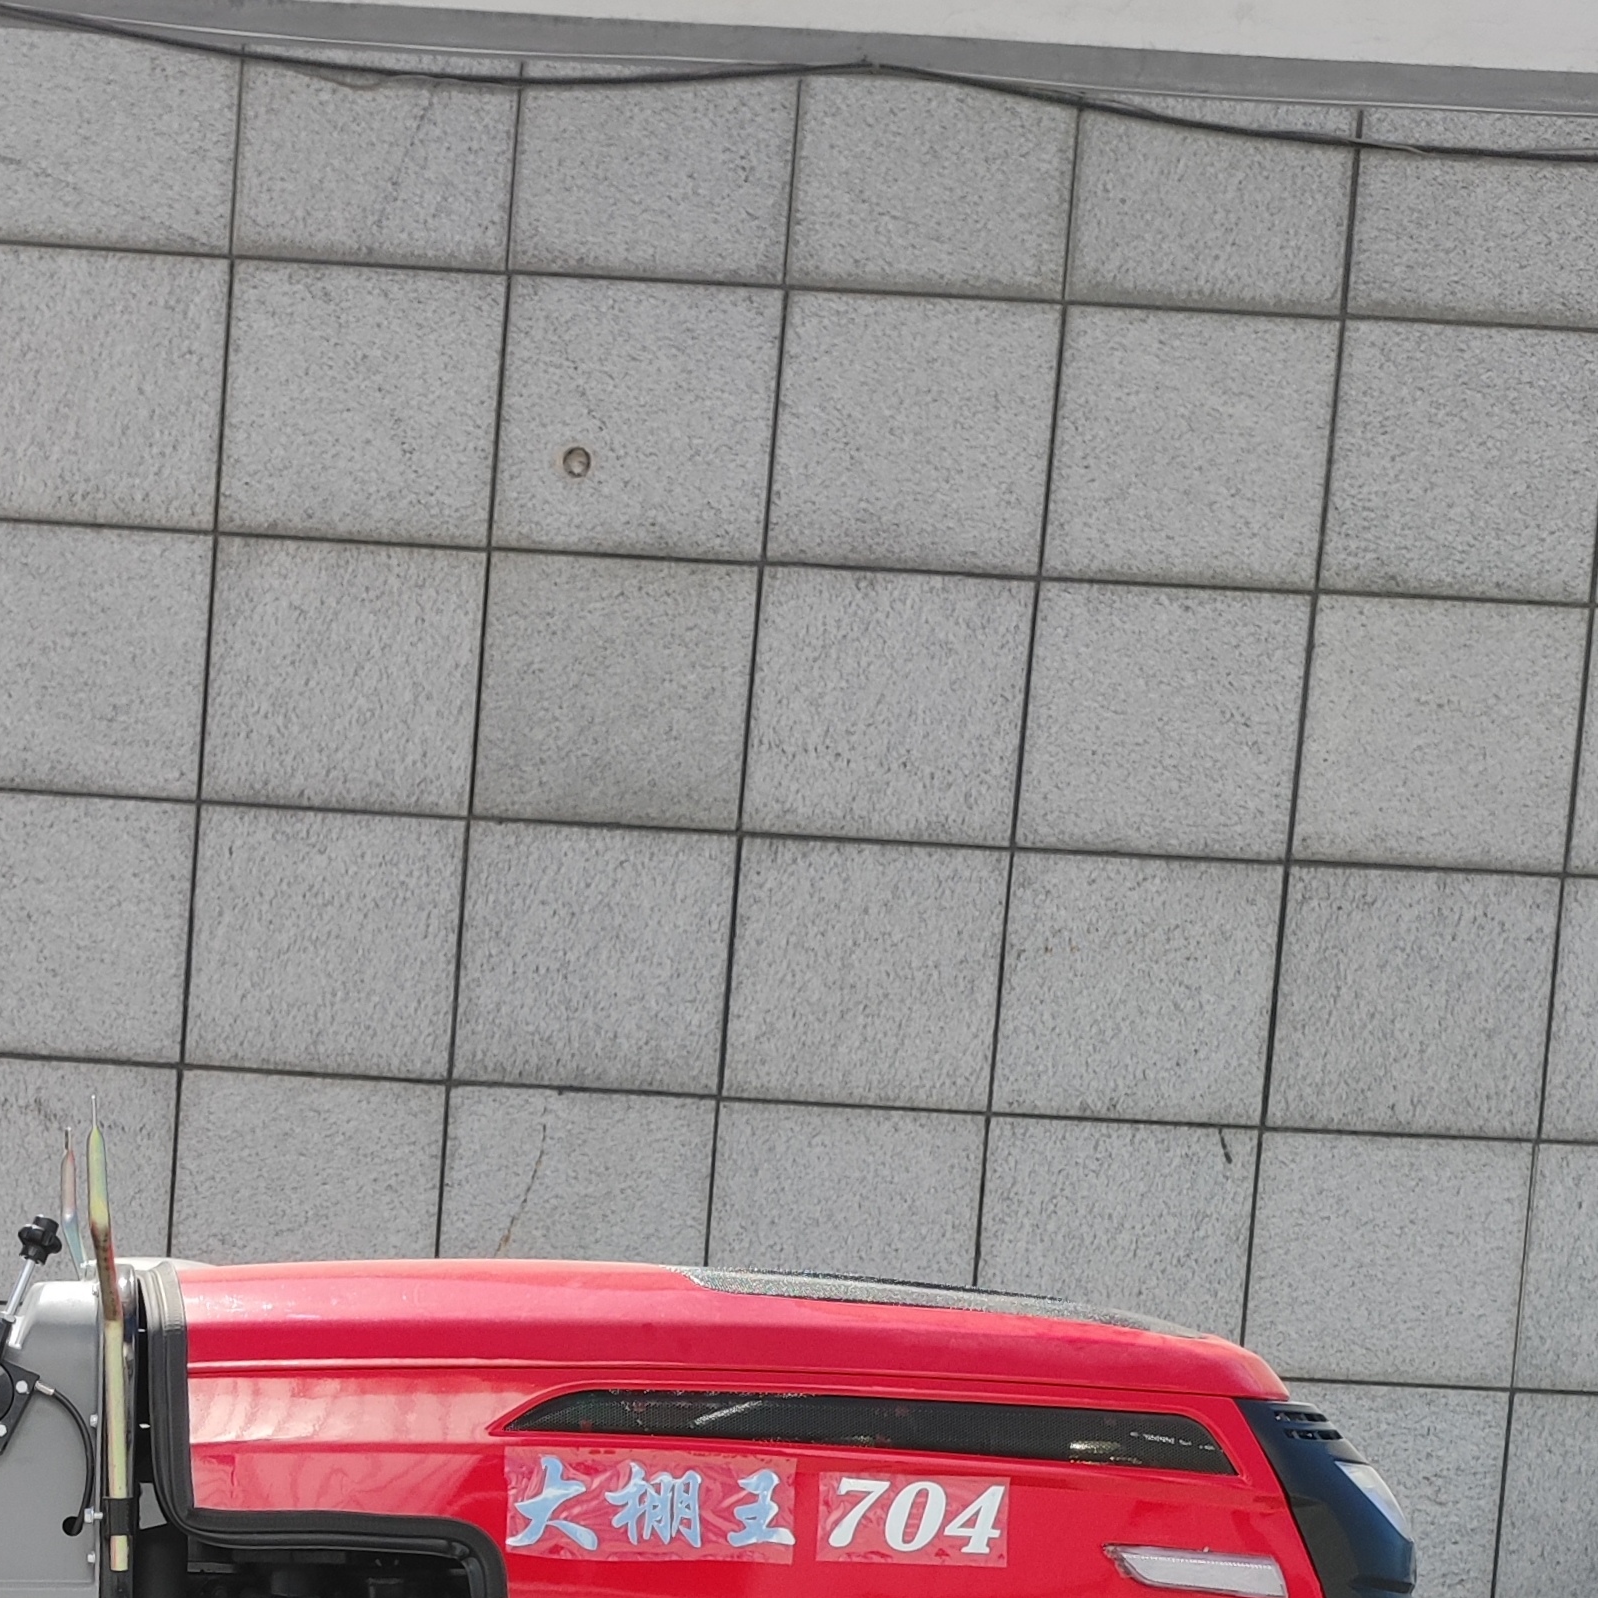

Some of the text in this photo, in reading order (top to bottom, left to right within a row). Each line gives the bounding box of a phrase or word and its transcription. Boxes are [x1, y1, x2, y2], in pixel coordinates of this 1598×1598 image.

[505, 1453, 1007, 1555] 大棚王 704
